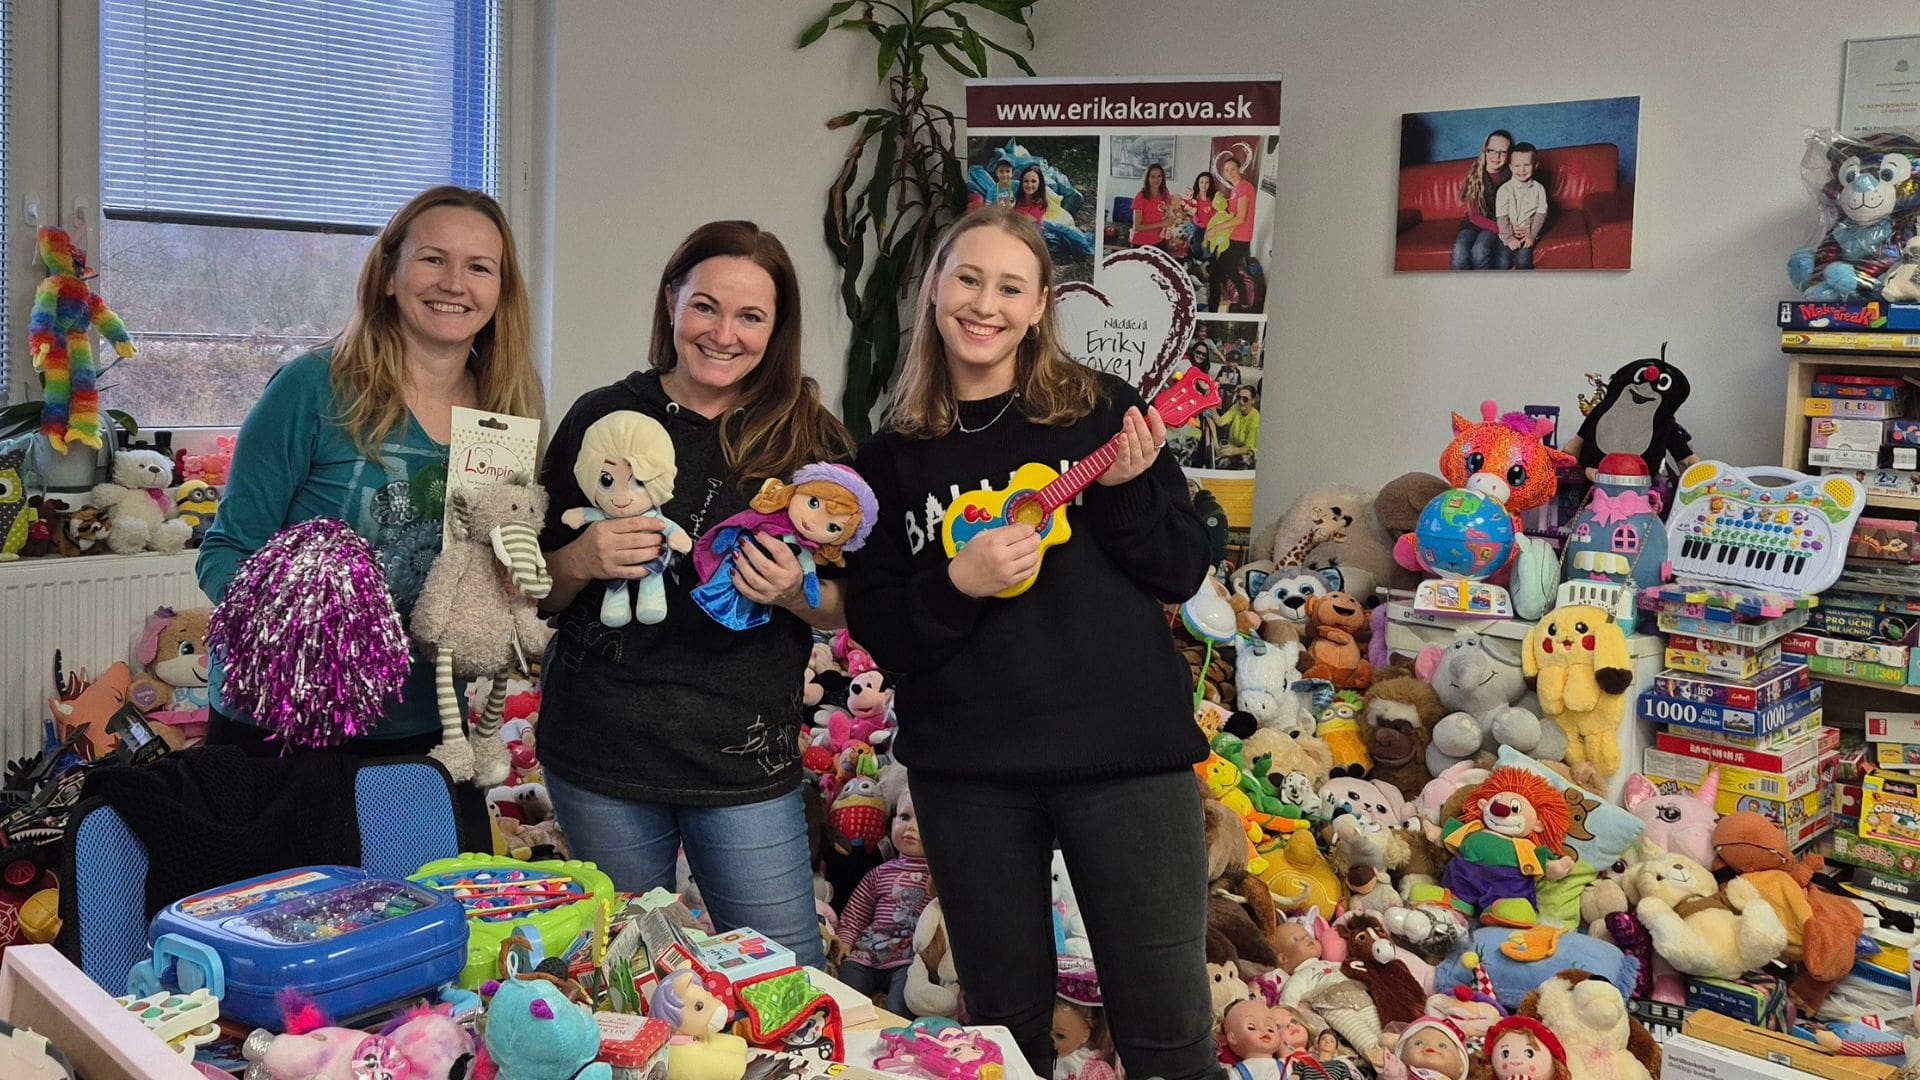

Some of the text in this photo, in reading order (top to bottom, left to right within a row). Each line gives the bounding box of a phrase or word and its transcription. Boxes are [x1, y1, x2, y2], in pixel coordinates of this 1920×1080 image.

[996, 95, 1252, 121] www.erikakarova.sk
[1086, 329, 1145, 367] Eriky
[1825, 615, 1846, 625] PRO
[1791, 638, 1811, 649] Trefl
[1879, 668, 1900, 681] 300
[1697, 687, 1714, 697] 160
[1644, 699, 1697, 724] 1000
[1762, 705, 1785, 733] 1000
